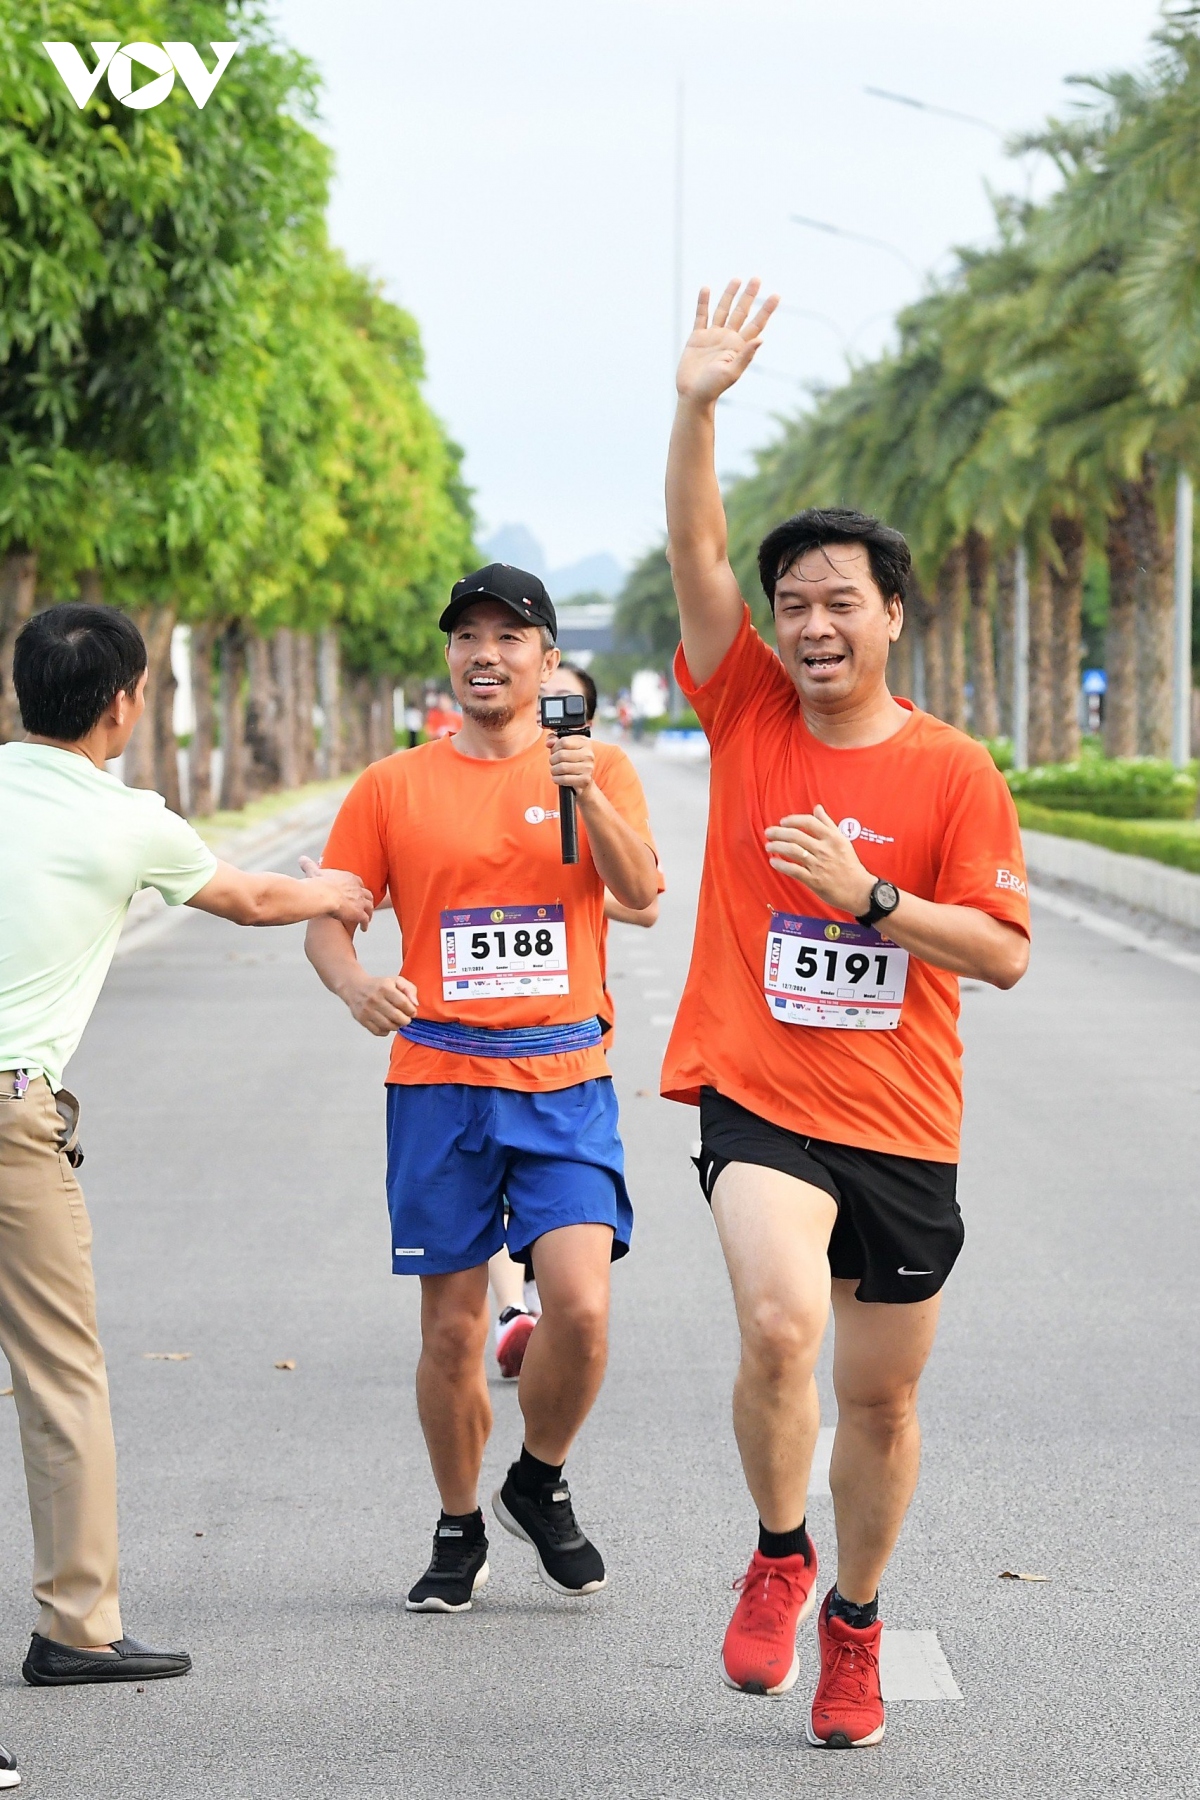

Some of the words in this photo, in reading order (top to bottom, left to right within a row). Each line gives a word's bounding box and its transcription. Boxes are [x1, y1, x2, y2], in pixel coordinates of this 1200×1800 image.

[783, 919, 803, 930] VOV
[447, 936, 456, 953] KM
[470, 928, 554, 960] 5188
[771, 942, 782, 962] KM
[448, 957, 456, 965] 5
[795, 945, 888, 986] 5191
[770, 968, 778, 976] 5
[782, 982, 807, 993] 12/7/2024
